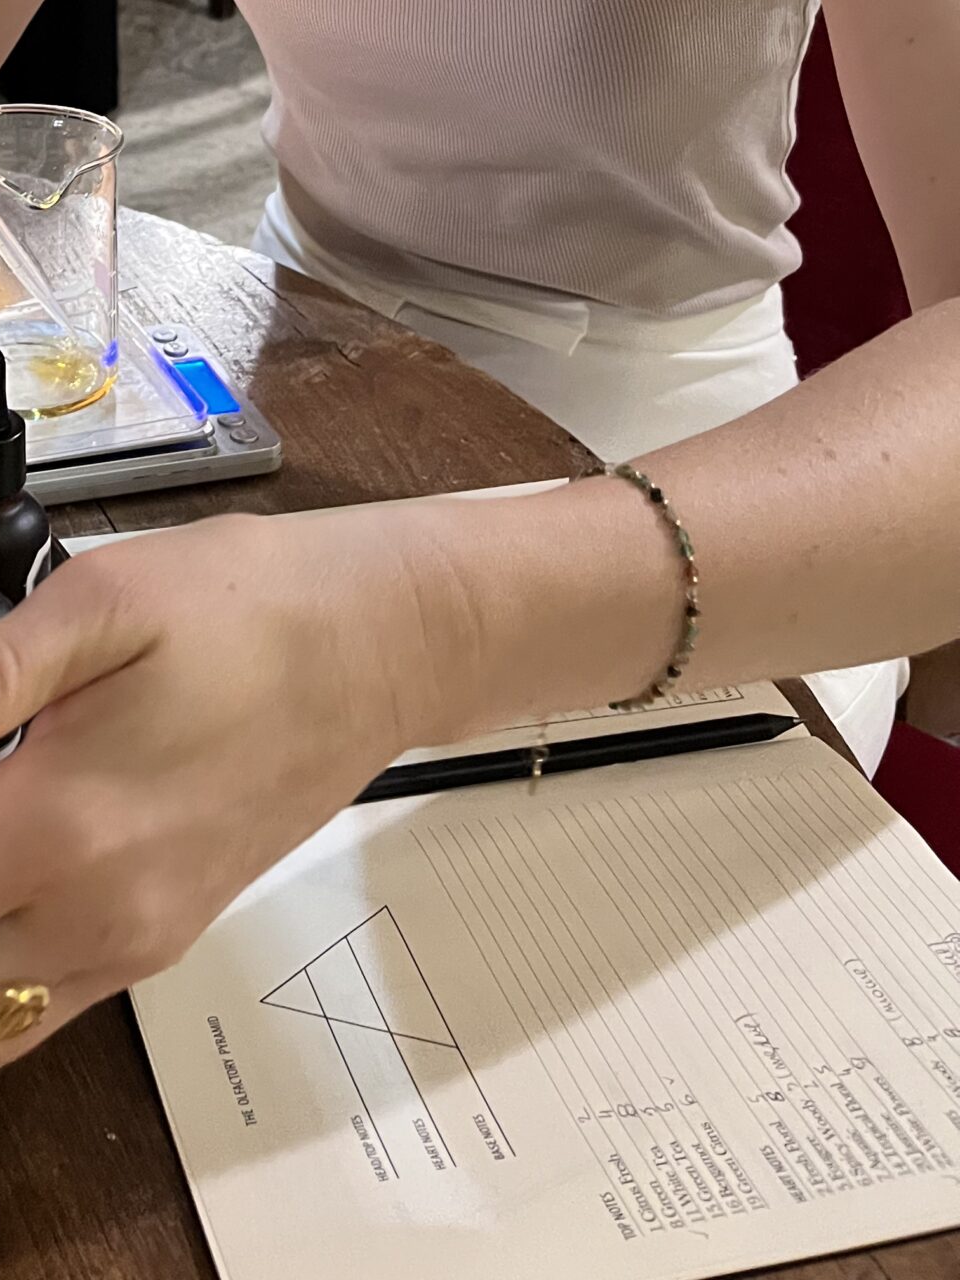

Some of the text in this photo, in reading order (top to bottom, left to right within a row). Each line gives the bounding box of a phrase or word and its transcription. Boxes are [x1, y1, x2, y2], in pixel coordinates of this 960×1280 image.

[206, 1014, 257, 1126] THE OLFACTORY PYRAMID
[829, 1081, 861, 1112] Floral
[472, 1113, 504, 1160] BASE NOTES
[768, 1119, 800, 1153] Floral
[799, 1099, 836, 1141] Woody
[349, 1114, 389, 1181] HEAD/TOP NOTES
[412, 1117, 446, 1170] HEART NOTES
[648, 1145, 668, 1170] Tea
[666, 1139, 687, 1165] Tea
[698, 1121, 728, 1157] Citrus
[605, 1152, 634, 1185] Fresh
[690, 1142, 734, 1199] Bergamot
[723, 1157, 754, 1194] Green
[759, 1144, 786, 1172] NOTES
[647, 1179, 677, 1218] Green
[663, 1169, 692, 1206] White
[684, 1165, 713, 1202] Green
[599, 1190, 636, 1240] TOP NOTES
[626, 1185, 657, 1223] Citrus
